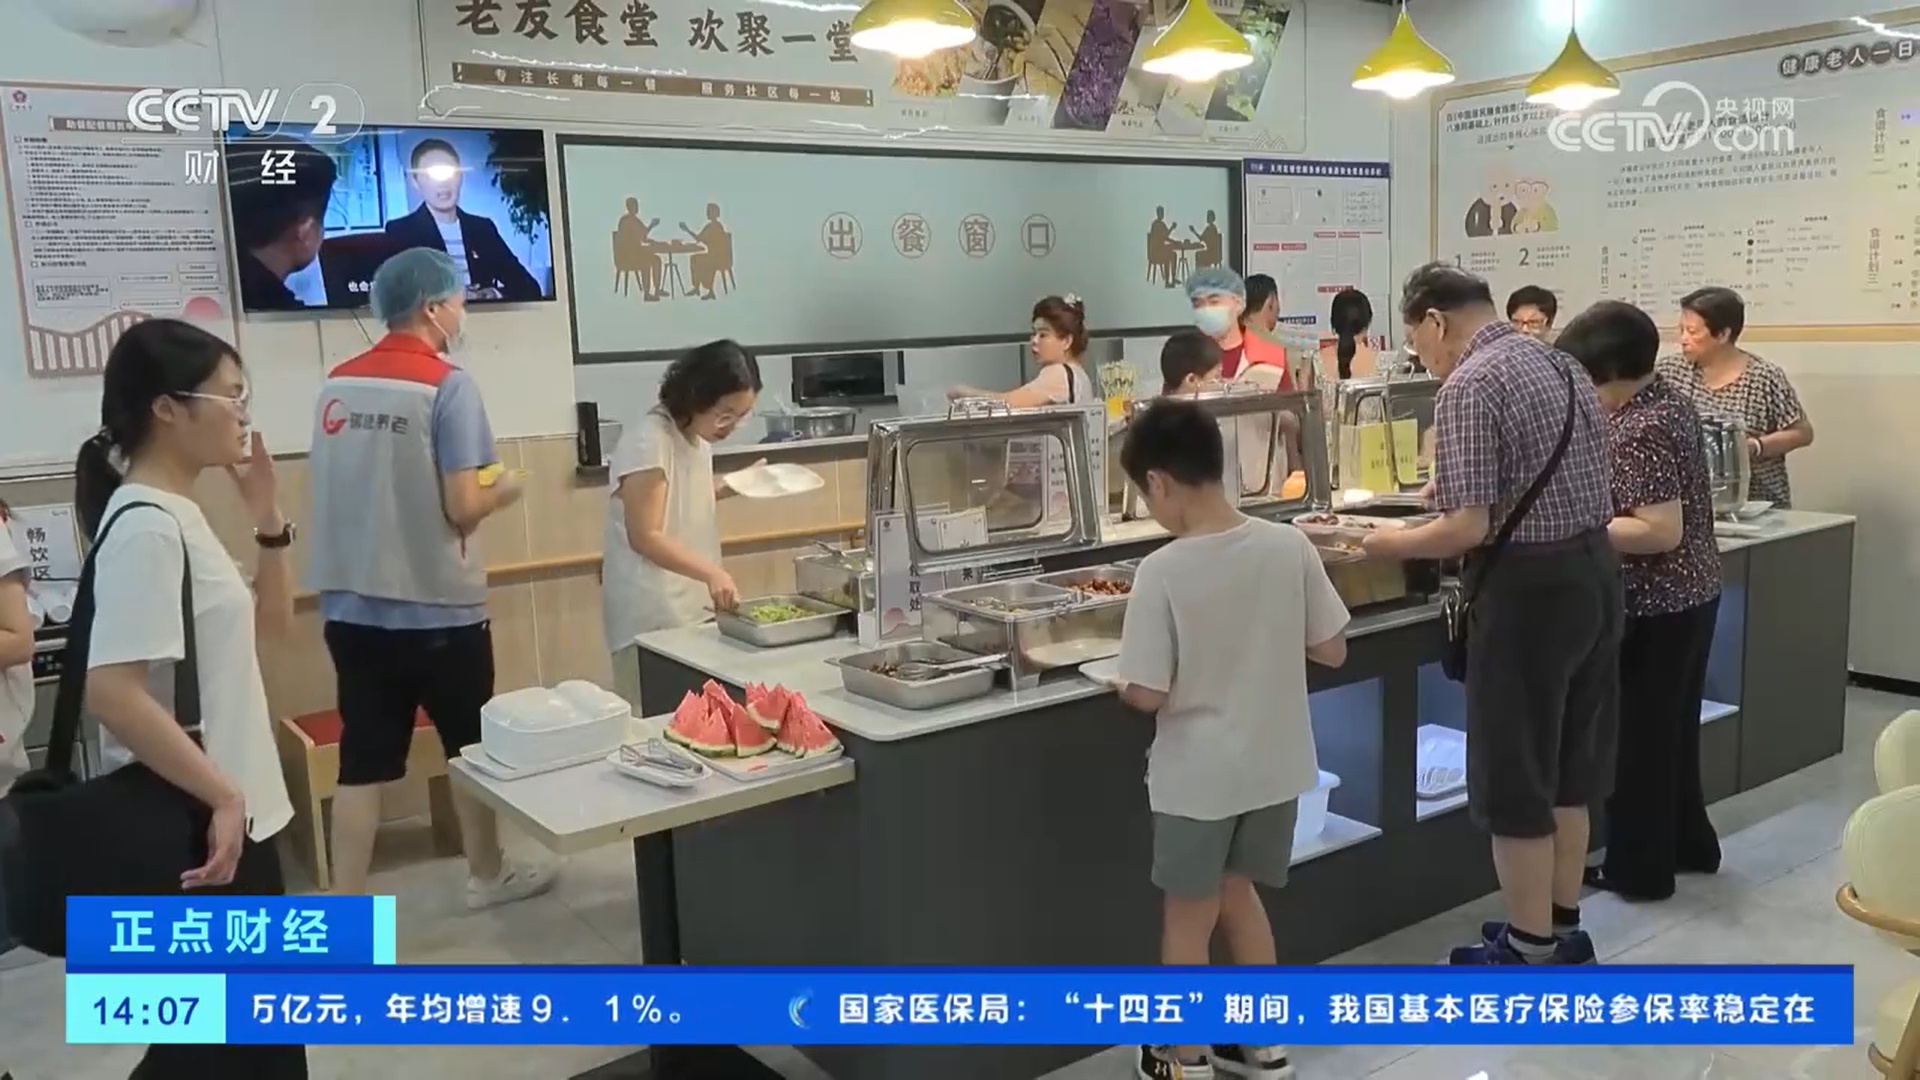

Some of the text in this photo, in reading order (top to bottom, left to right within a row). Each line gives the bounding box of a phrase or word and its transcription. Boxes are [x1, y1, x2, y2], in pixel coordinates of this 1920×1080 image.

[456, 0, 859, 62] 老友食堂 欢聚一堂
[1782, 40, 1914, 77] 健康老人一日
[494, 68, 841, 103] 专注长者每一餐 服务社区每一站
[826, 215, 1051, 254] 出餐窗口
[1518, 248, 1530, 266] 2
[27, 527, 50, 579] 畅饮区
